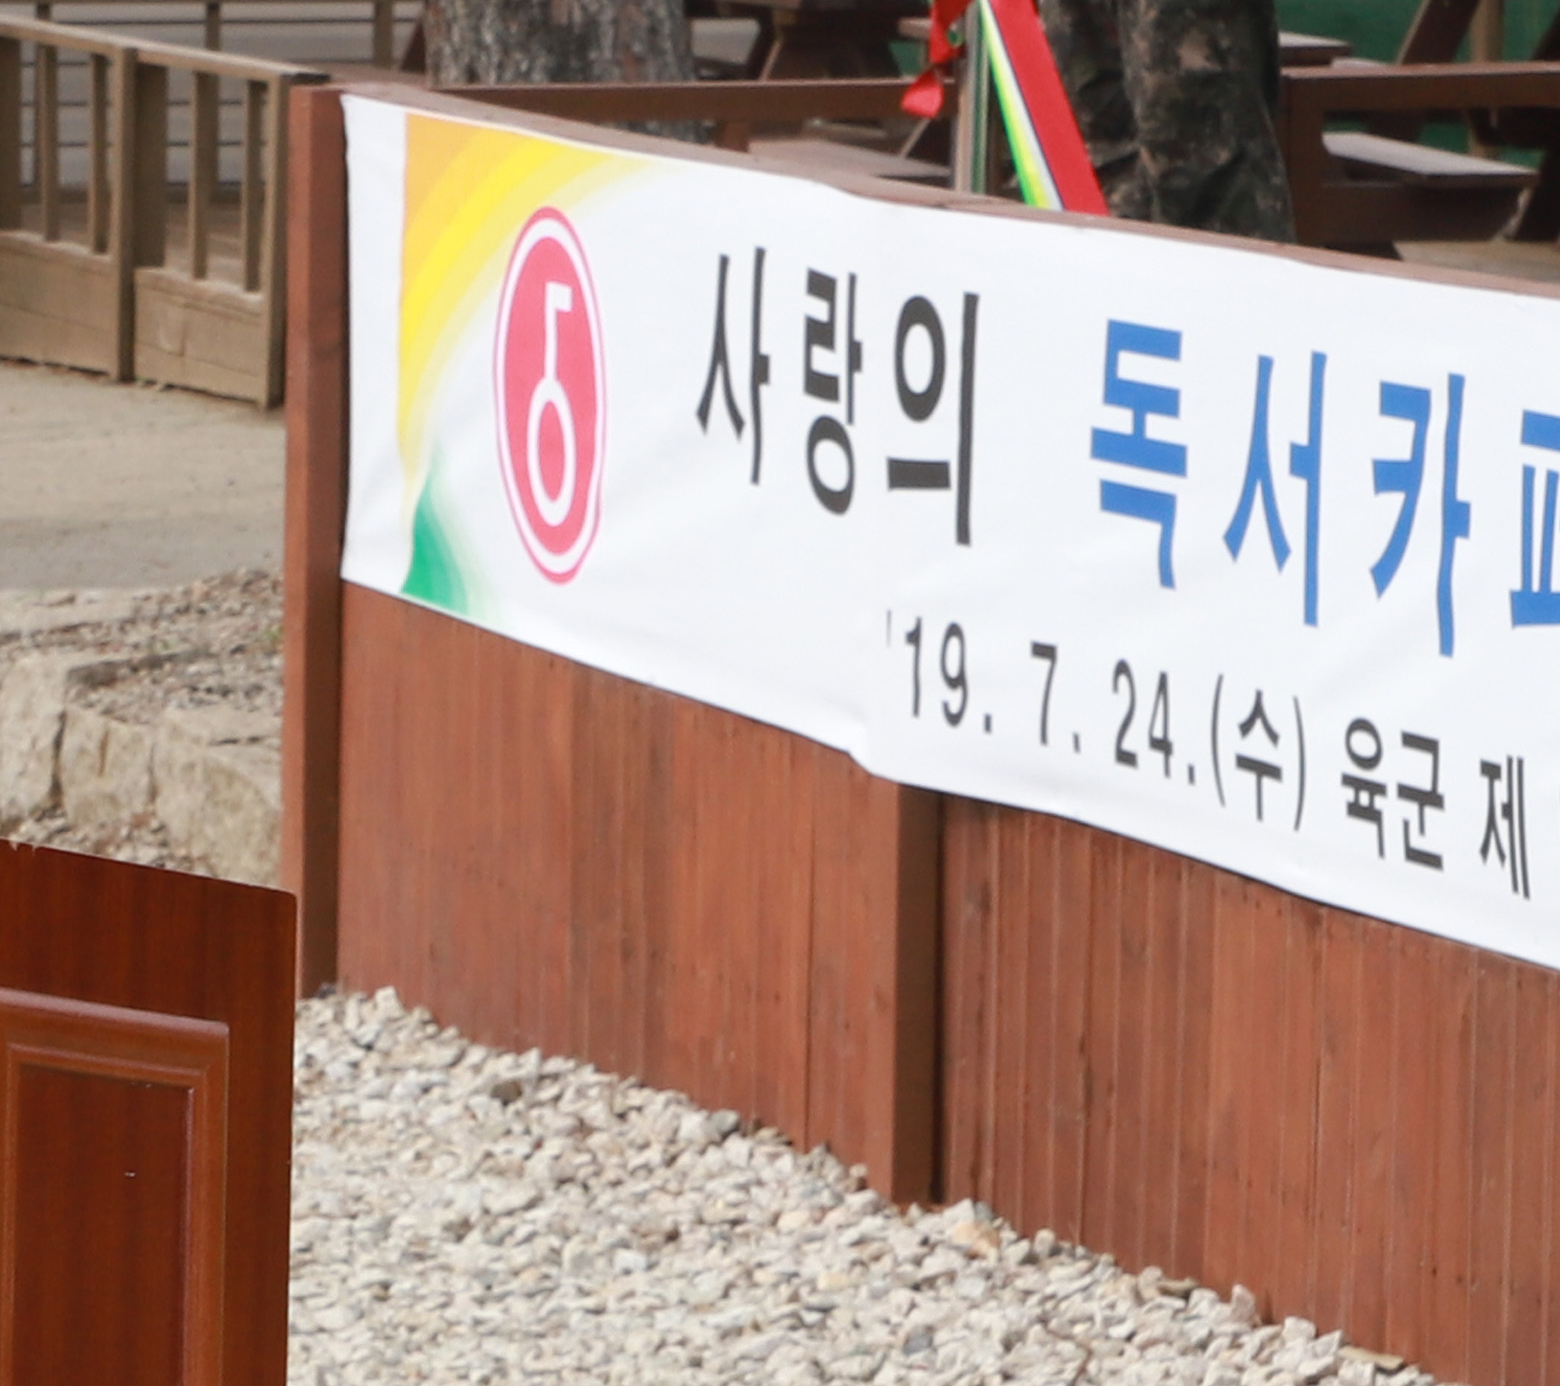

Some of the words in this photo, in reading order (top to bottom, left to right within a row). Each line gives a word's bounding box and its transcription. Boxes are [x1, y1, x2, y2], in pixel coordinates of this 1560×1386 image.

[695, 245, 980, 547] 사랑의
[1030, 641, 1080, 753] 7.
[1340, 716, 1445, 873] 육군
[1479, 754, 1531, 901] 제
